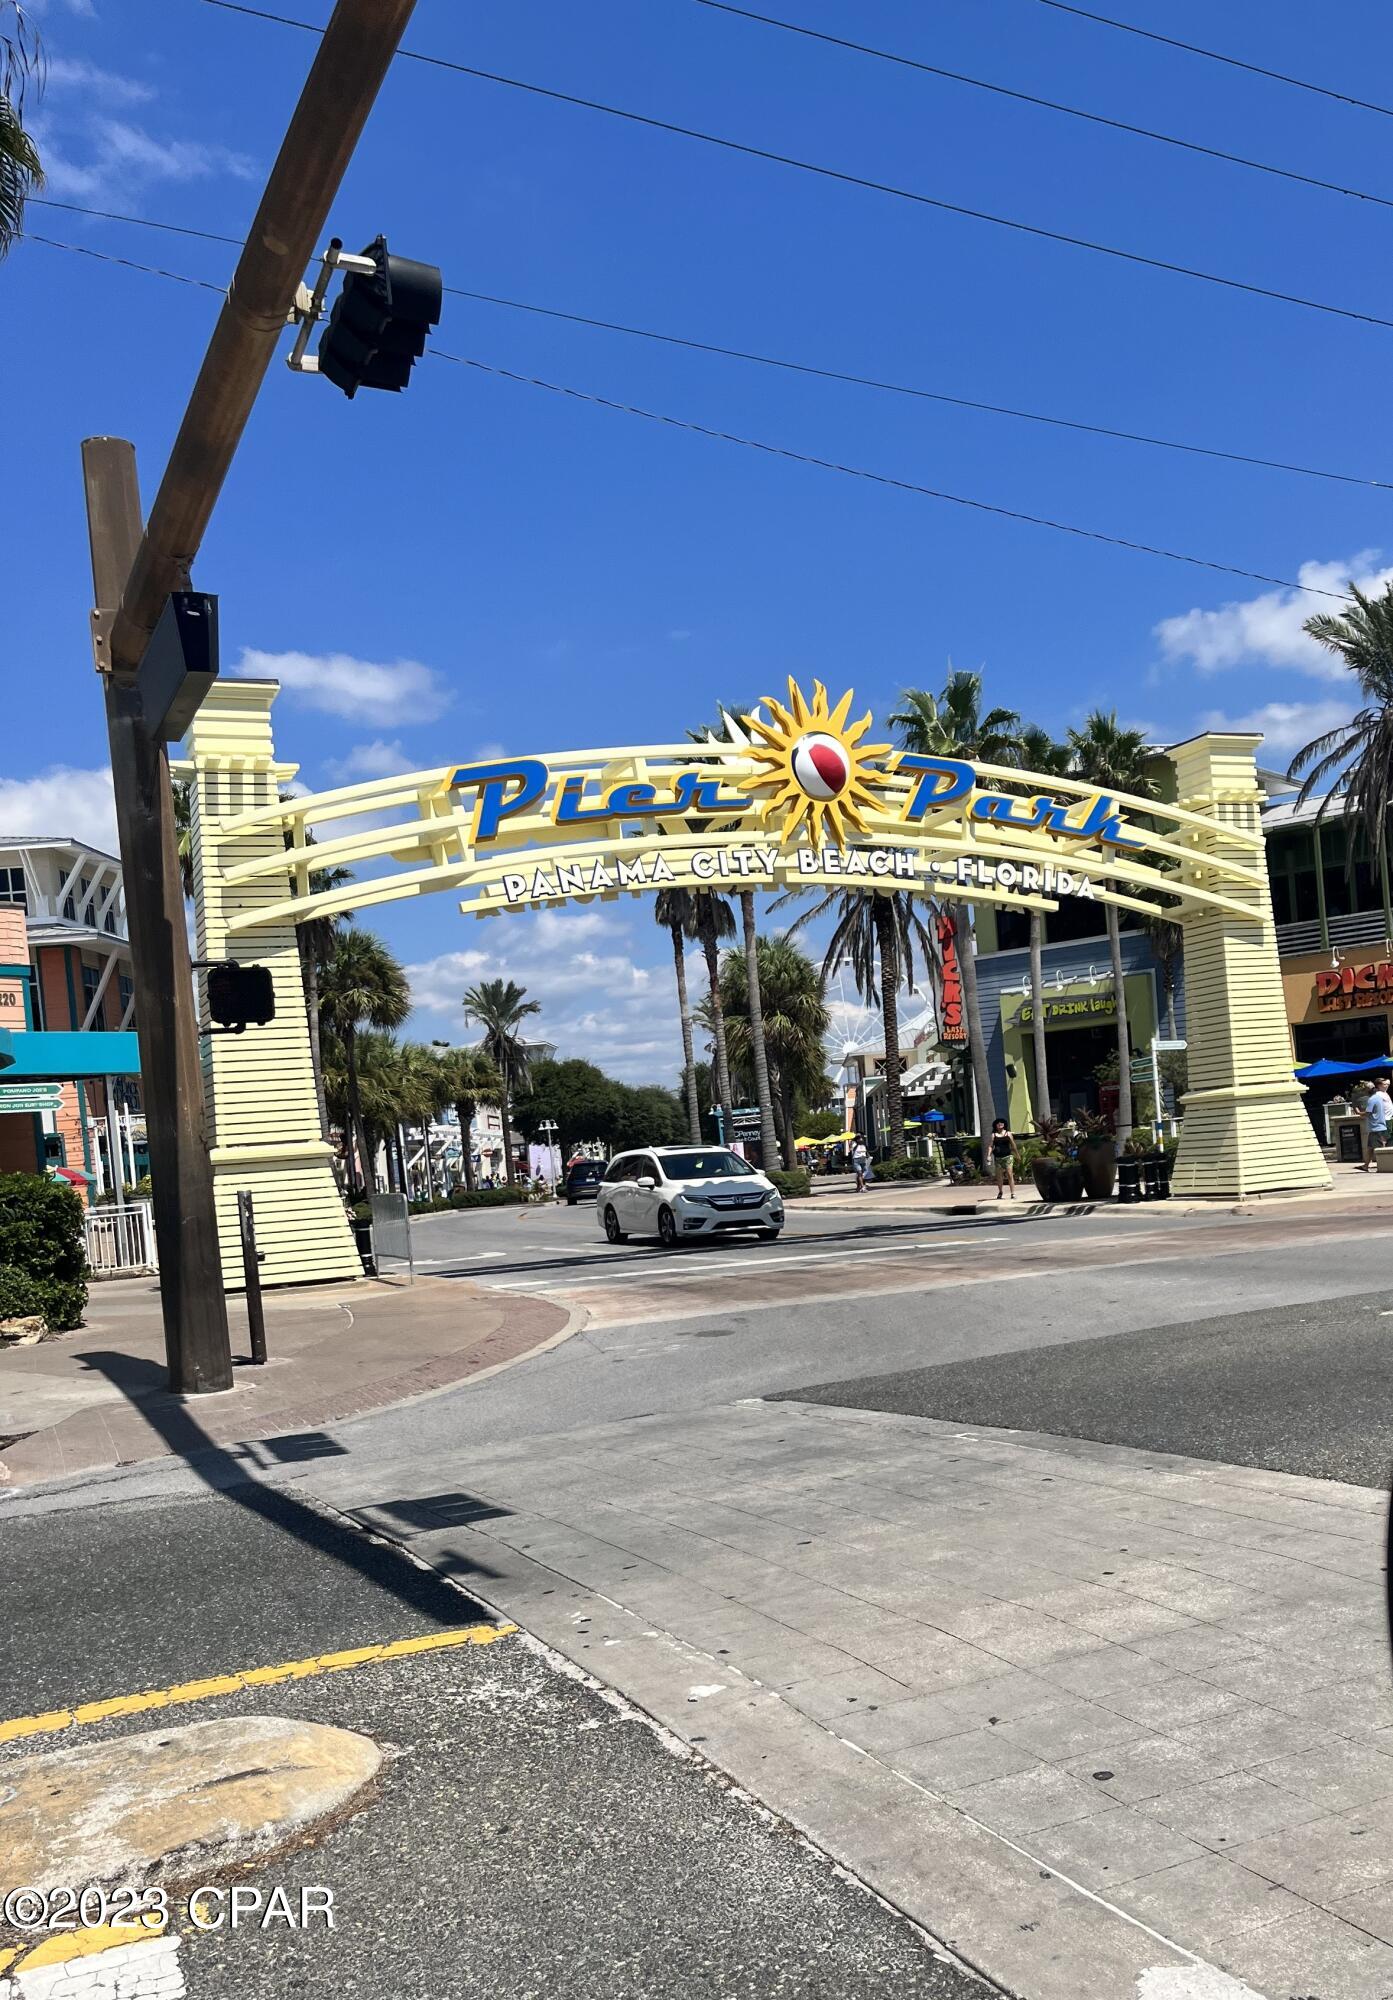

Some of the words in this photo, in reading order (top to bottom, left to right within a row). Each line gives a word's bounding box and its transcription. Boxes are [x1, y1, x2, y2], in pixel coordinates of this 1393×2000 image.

[448, 758, 754, 844] Pier
[889, 752, 1146, 854] Park
[503, 851, 676, 904] PANAMA
[690, 847, 781, 880] CITY
[798, 847, 916, 879] BEACH
[955, 856, 1098, 901] FLORIDA
[1020, 1003, 1050, 1021] ET
[1052, 1000, 1089, 1016] DRINK
[1318, 994, 1352, 1013] LAST
[943, 1032, 968, 1040] RESORT
[946, 1025, 963, 1033] LAST
